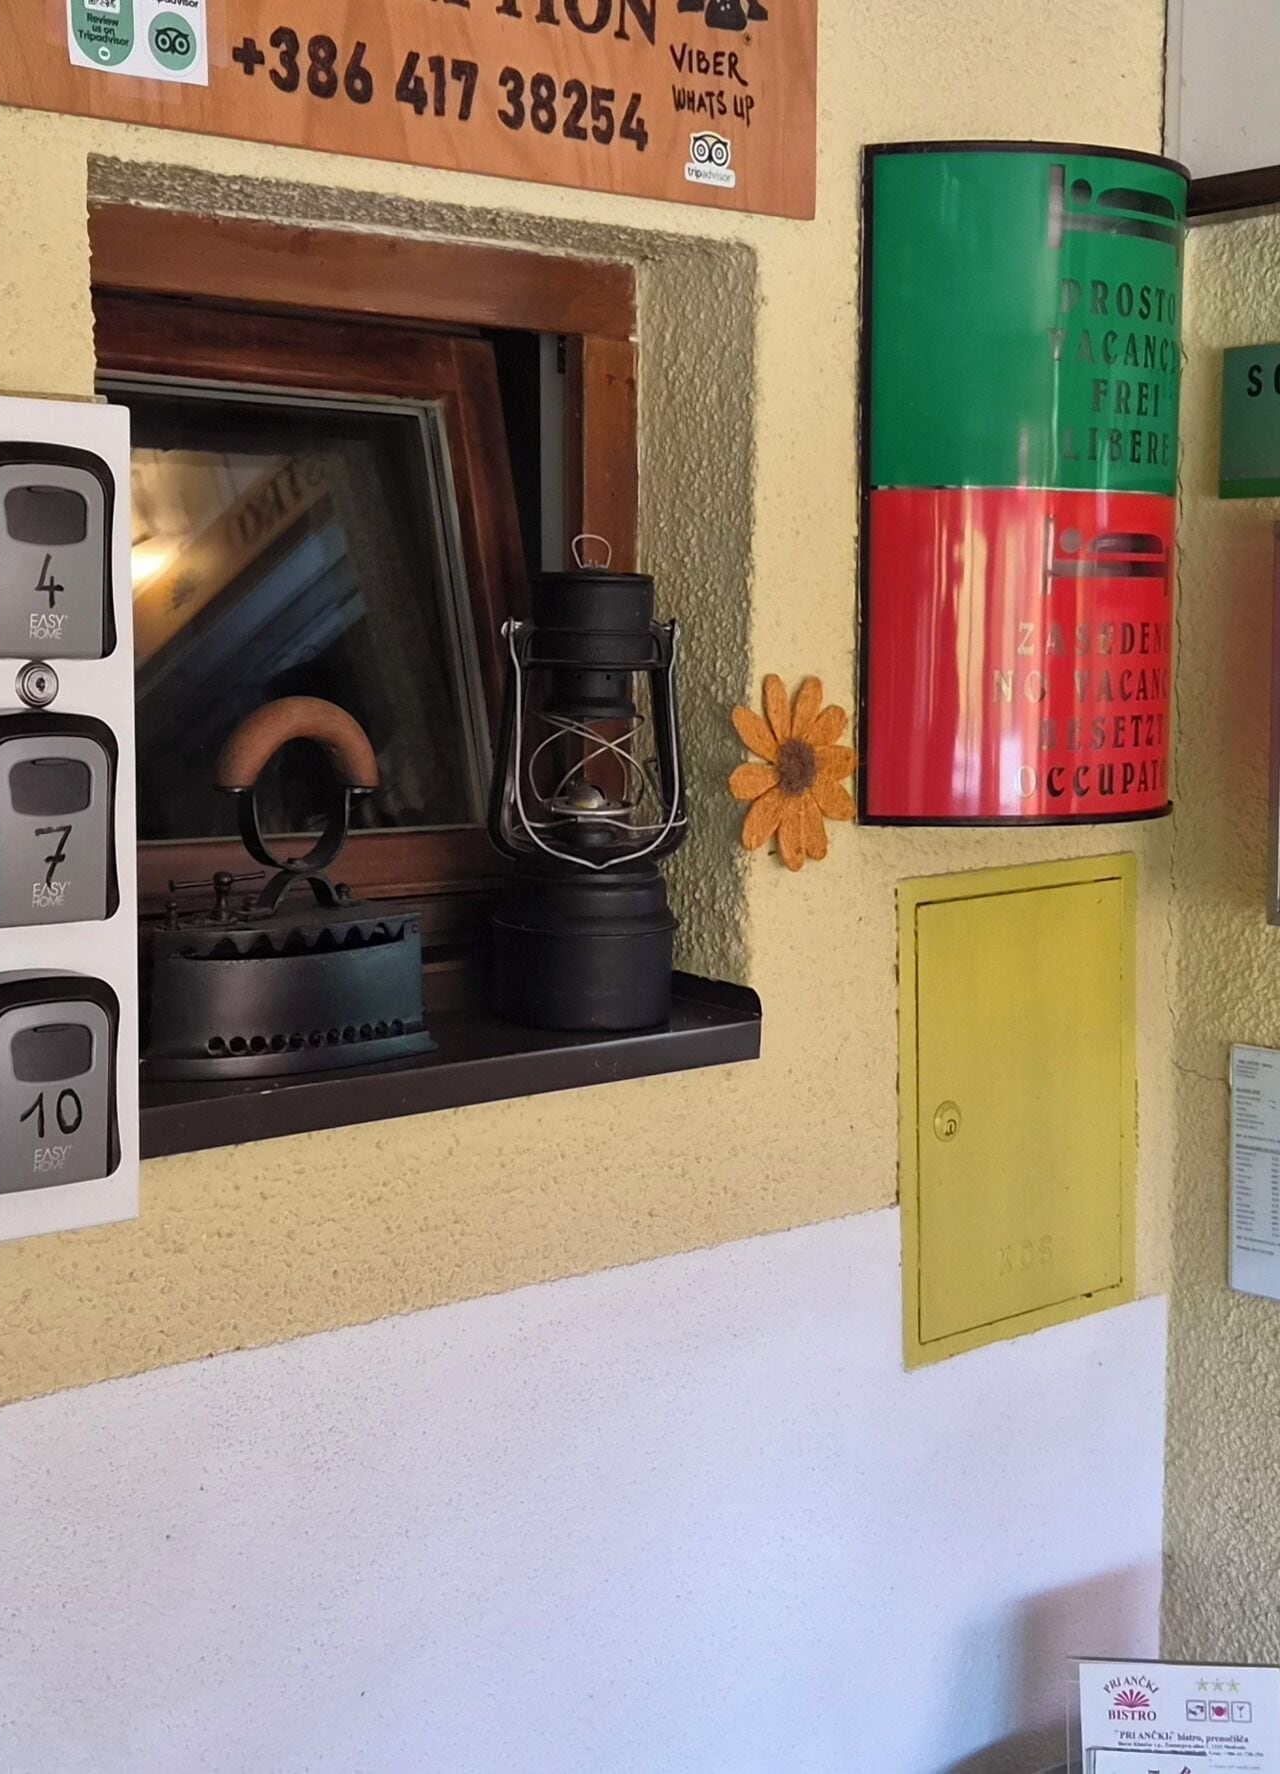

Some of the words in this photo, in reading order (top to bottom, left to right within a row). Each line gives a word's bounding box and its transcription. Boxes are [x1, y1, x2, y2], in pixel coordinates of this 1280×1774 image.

[86, 13, 119, 27] Review
[91, 25, 104, 33] us
[103, 26, 116, 38] on
[78, 30, 129, 46] Tripadvisor
[670, 42, 748, 87] VIBER
[232, 26, 373, 105] +386
[395, 51, 479, 121] 417
[497, 65, 649, 152] 38254
[672, 84, 727, 120] WHATS
[733, 93, 755, 128] UP
[687, 167, 732, 183] tripadvisor
[1091, 378, 1159, 418] FREI
[34, 553, 65, 609] 4
[29, 613, 65, 629] EASY
[29, 628, 63, 641] HOME
[992, 669, 1047, 703] NO
[1038, 713, 1164, 752] BESETZT
[34, 824, 72, 886] 7
[20, 1088, 83, 1139] 10
[1103, 1677, 1121, 1693] PRI
[1123, 1675, 1159, 1693] ANČKI
[1108, 1709, 1157, 1721] BISTRO
